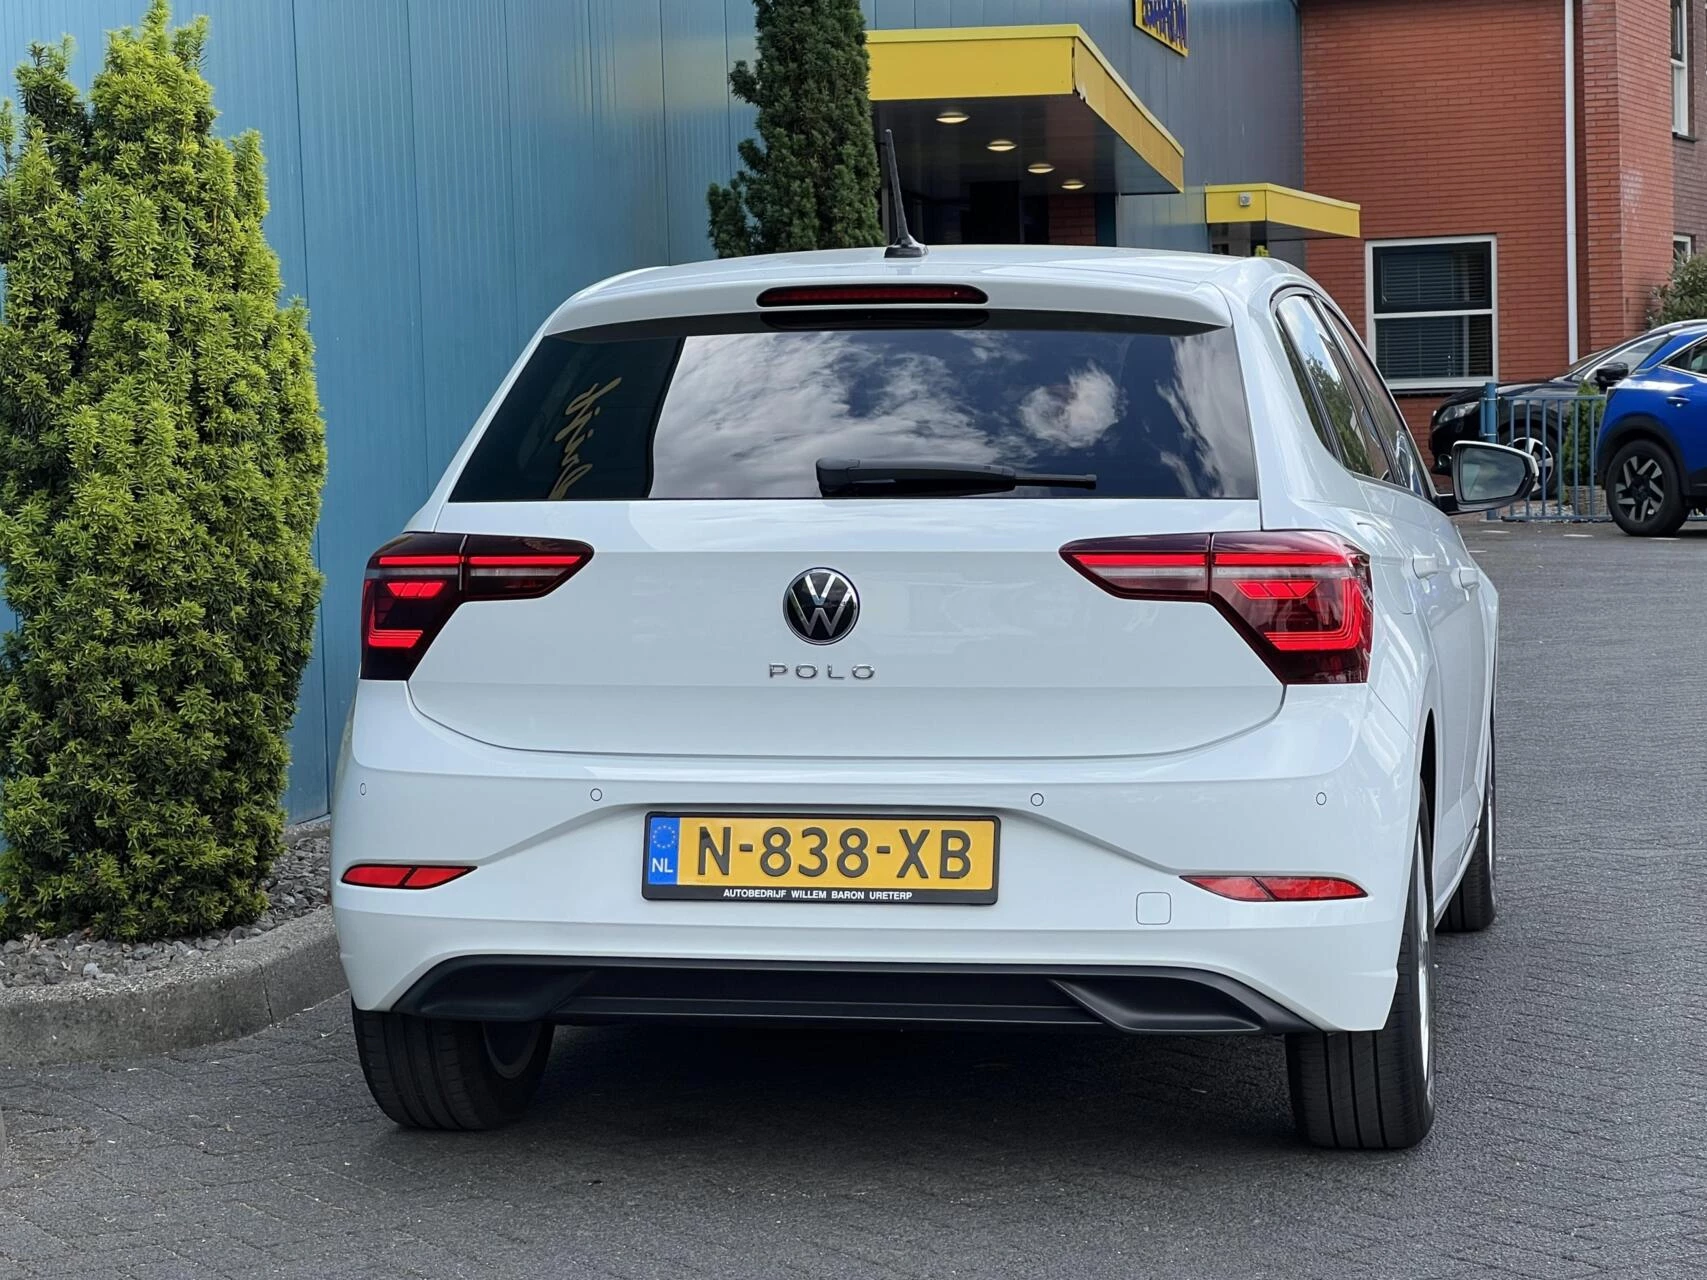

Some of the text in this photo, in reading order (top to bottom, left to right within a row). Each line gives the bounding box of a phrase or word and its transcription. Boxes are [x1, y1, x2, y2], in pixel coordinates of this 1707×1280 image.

[768, 662, 876, 680] POLO
[697, 826, 972, 879] N-838-XB
[651, 857, 674, 873] NL
[723, 888, 913, 900] AUTOBEDRIJF WILLEM BARON URETERP
